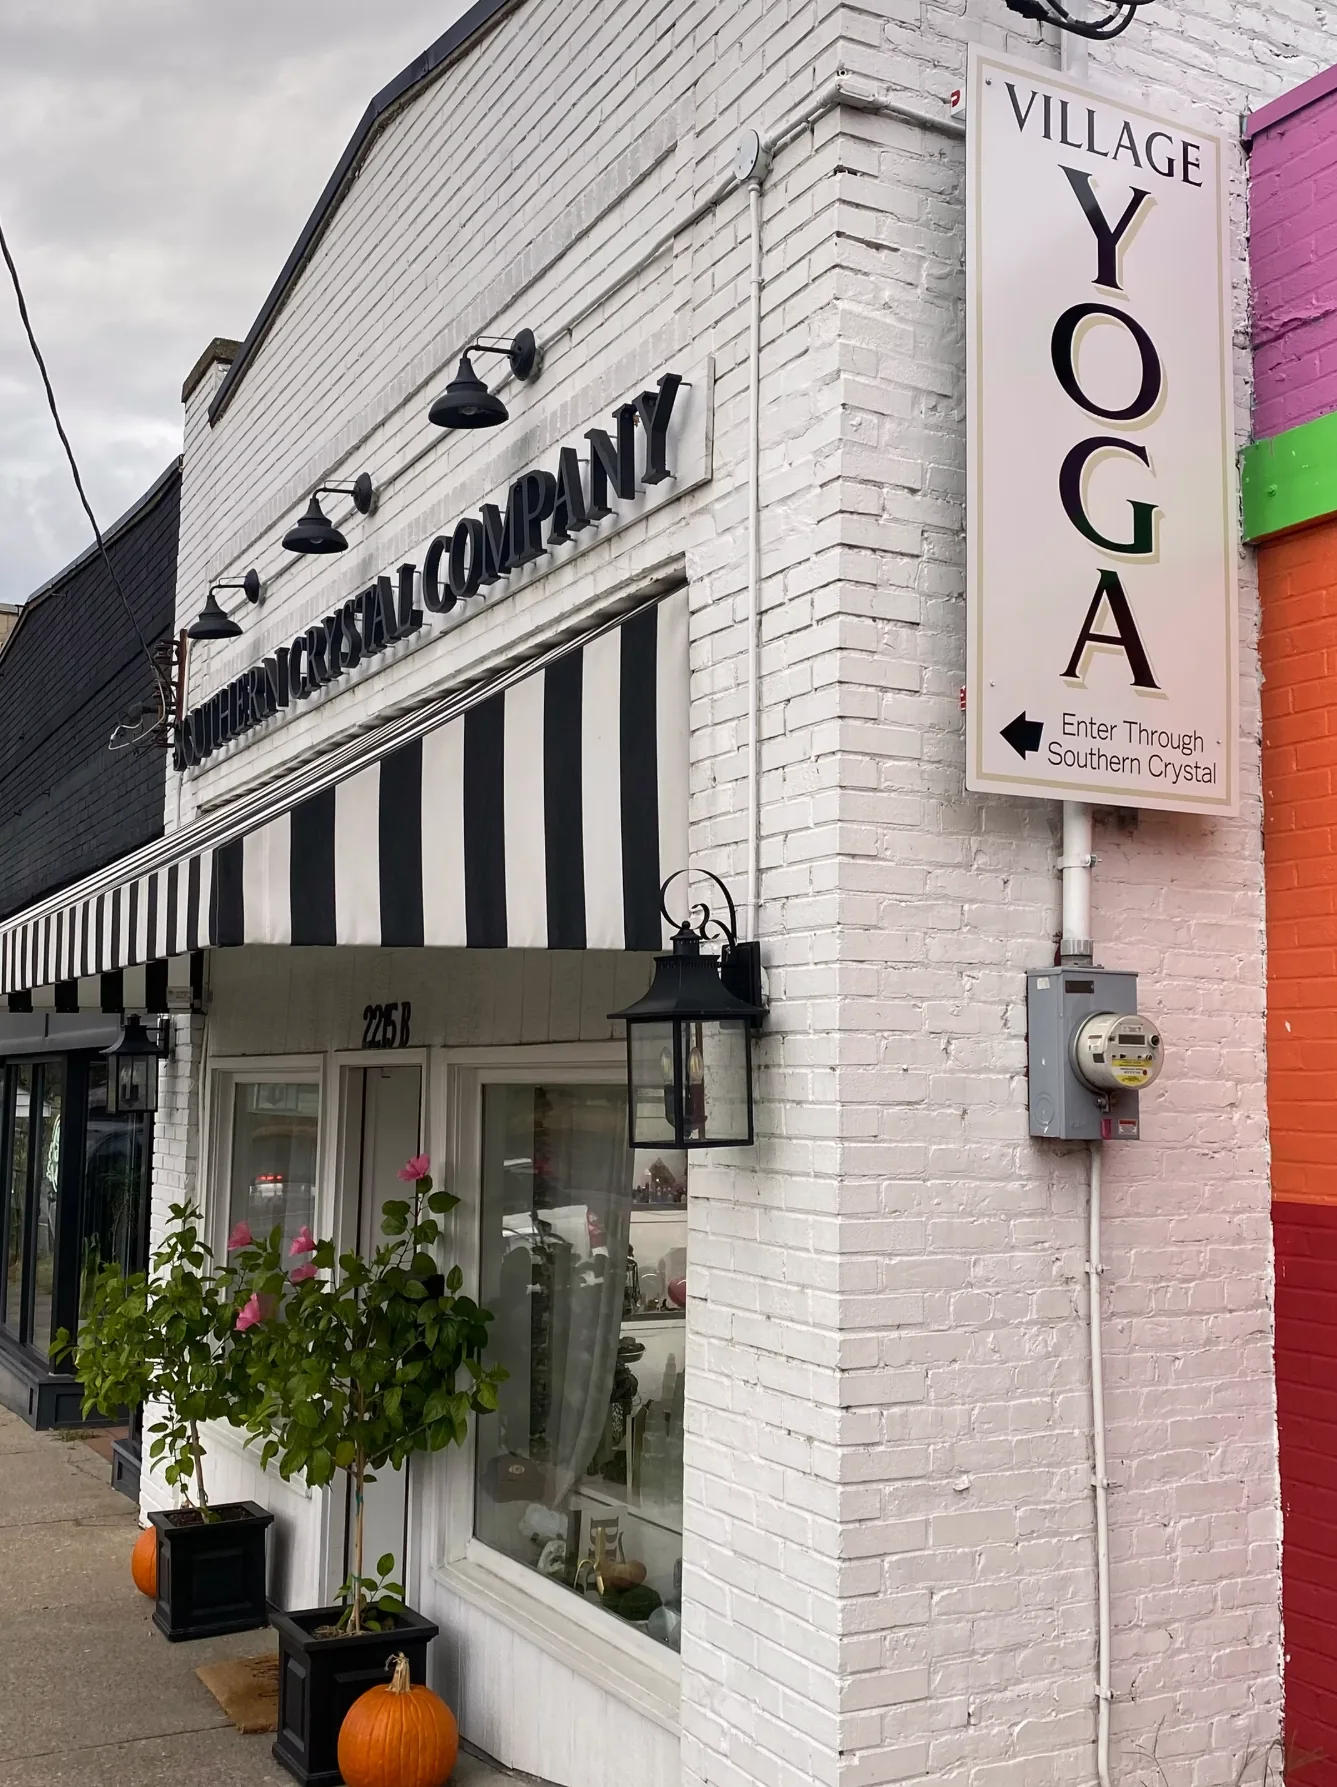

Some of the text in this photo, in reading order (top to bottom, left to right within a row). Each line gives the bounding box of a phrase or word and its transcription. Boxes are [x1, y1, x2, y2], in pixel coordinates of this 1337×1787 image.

[1004, 82, 1203, 188] VILLAGE
[1051, 164, 1166, 696] YOGA
[289, 563, 424, 700] CRYSTAL
[423, 373, 682, 613] COMPANY
[1048, 741, 1216, 784] Southern Crystal
[1062, 712, 1204, 756] Enter Through
